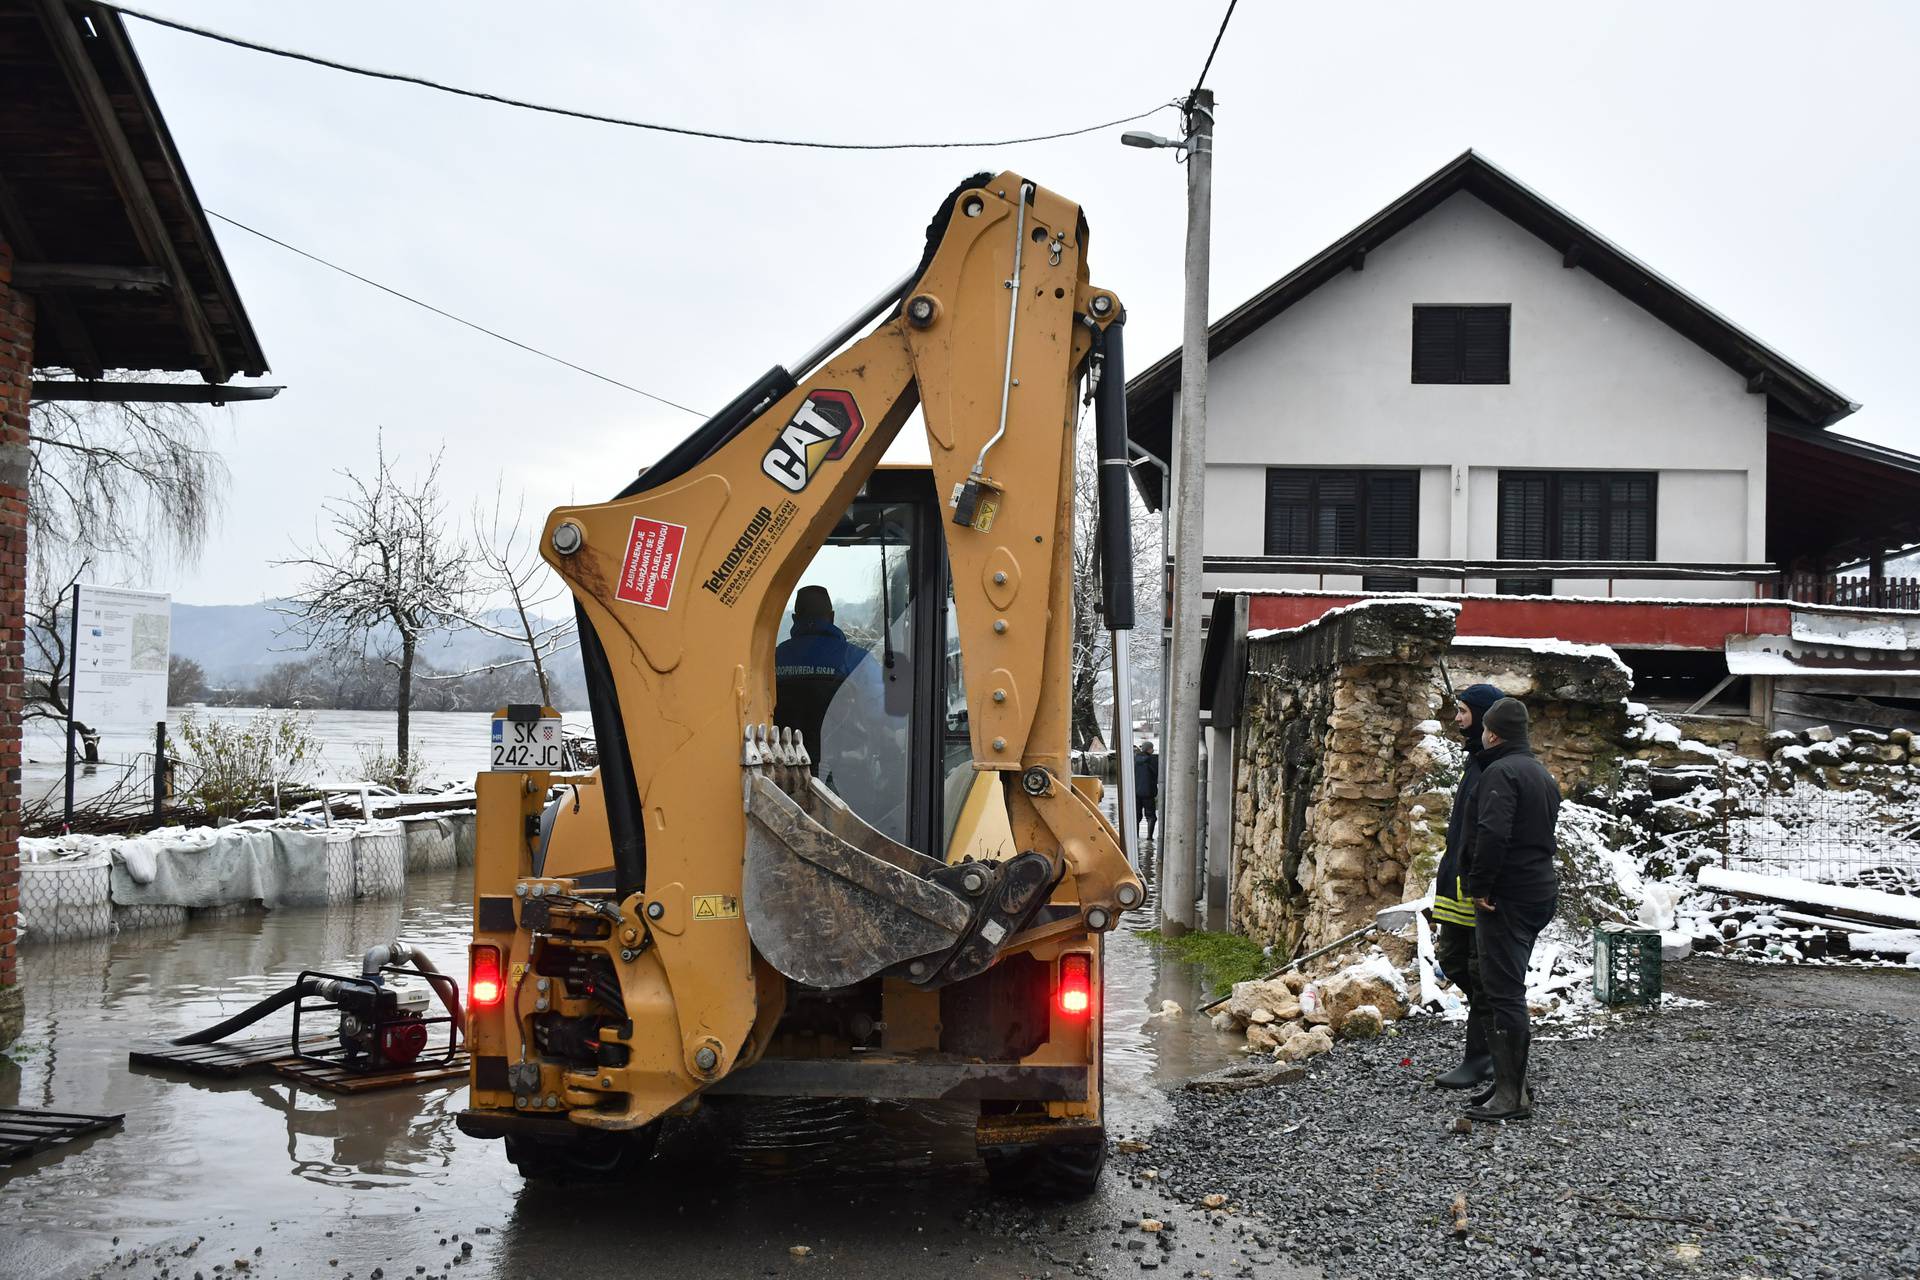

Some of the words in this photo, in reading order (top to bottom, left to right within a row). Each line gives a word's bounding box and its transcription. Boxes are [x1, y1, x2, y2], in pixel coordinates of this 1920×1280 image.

[763, 399, 842, 491] CAT
[625, 540, 643, 588] ZABRANJENO
[637, 531, 646, 541] JE
[635, 548, 652, 592] ZADRŽAVATI
[645, 538, 655, 549] SE
[644, 572, 658, 602] RADNOM
[651, 524, 669, 571] DJELOKRUGU
[660, 553, 673, 579] STROJA
[702, 505, 774, 595] Teknoxgroup
[719, 569, 746, 603] PRODAJA
[745, 537, 767, 564] SERVIS
[767, 499, 793, 534] DIJELOVI
[776, 665, 815, 675] DOPRIVREDA
[816, 666, 835, 675] SISAK
[514, 722, 538, 743] SK
